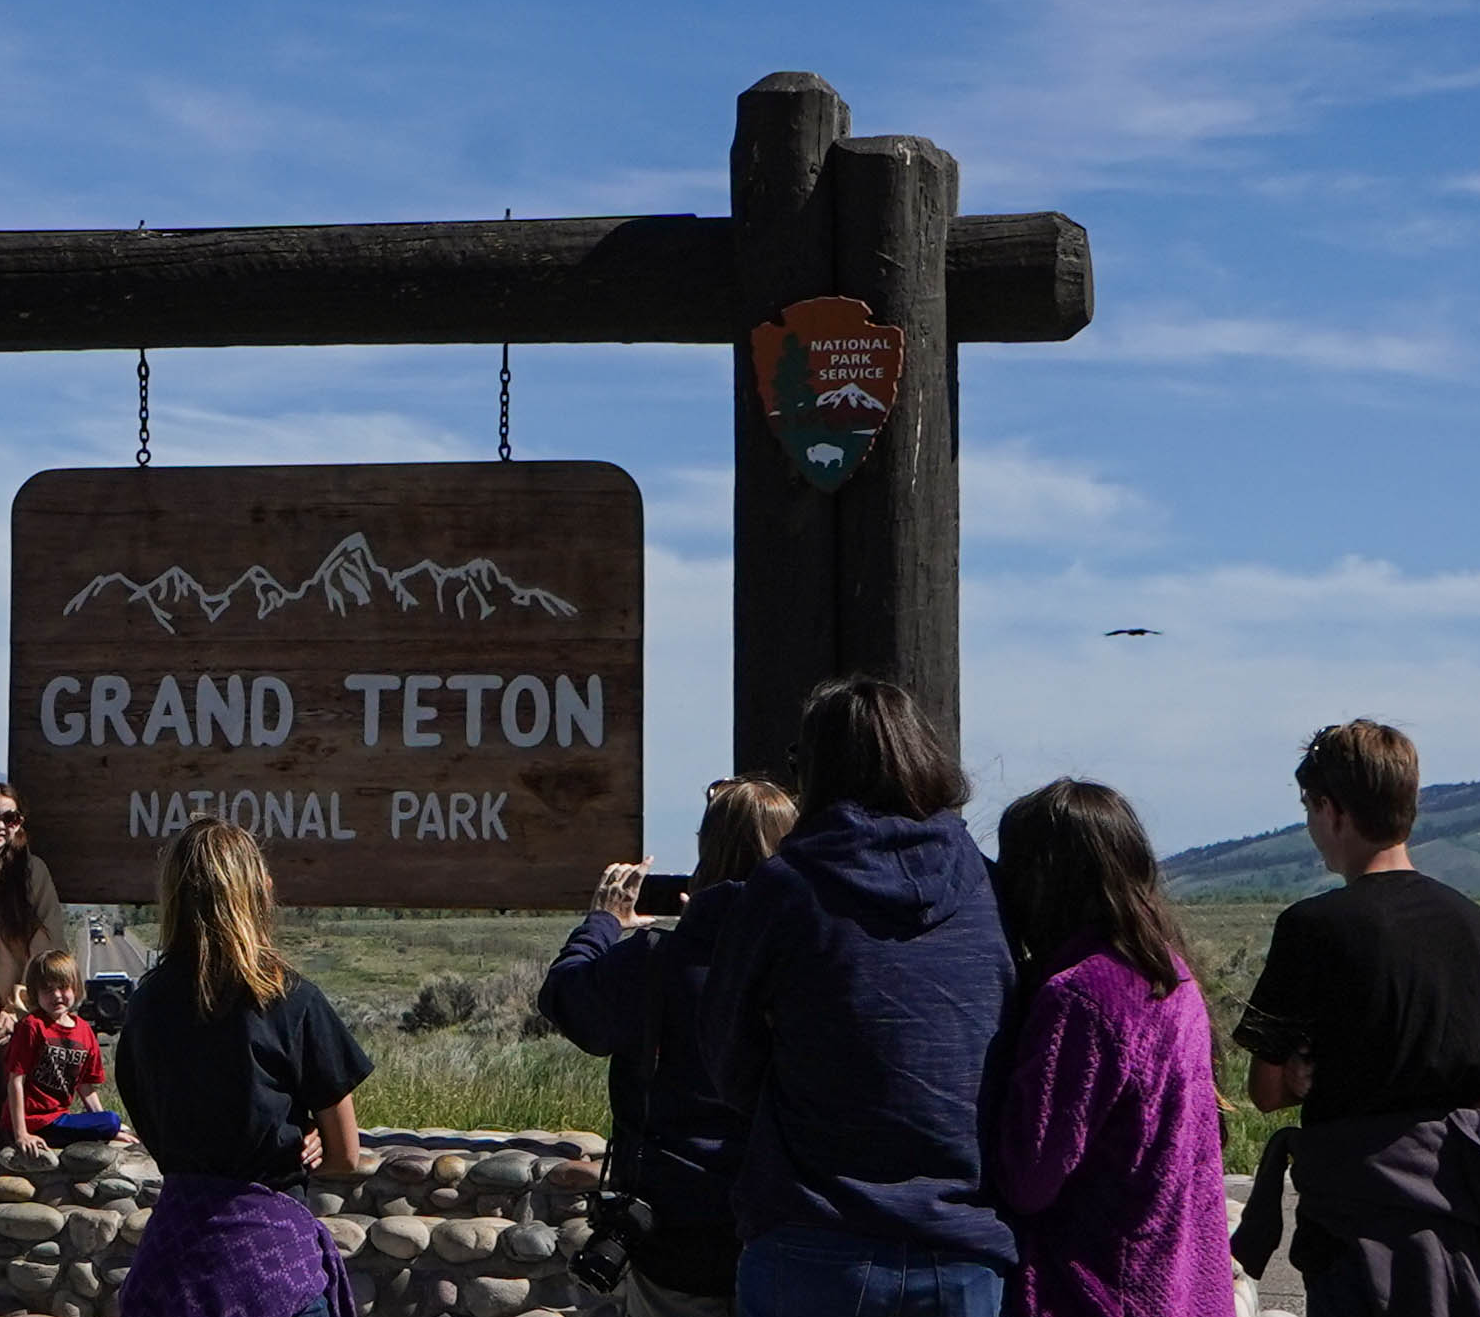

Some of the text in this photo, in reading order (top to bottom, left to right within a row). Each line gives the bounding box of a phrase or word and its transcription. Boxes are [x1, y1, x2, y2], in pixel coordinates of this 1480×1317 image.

[810, 339, 891, 351] NATIONAL
[830, 354, 871, 365] PARK
[819, 368, 884, 380] SERVICE
[41, 674, 604, 747] GRAND TETON
[129, 790, 508, 841] NATIONAL PARK
